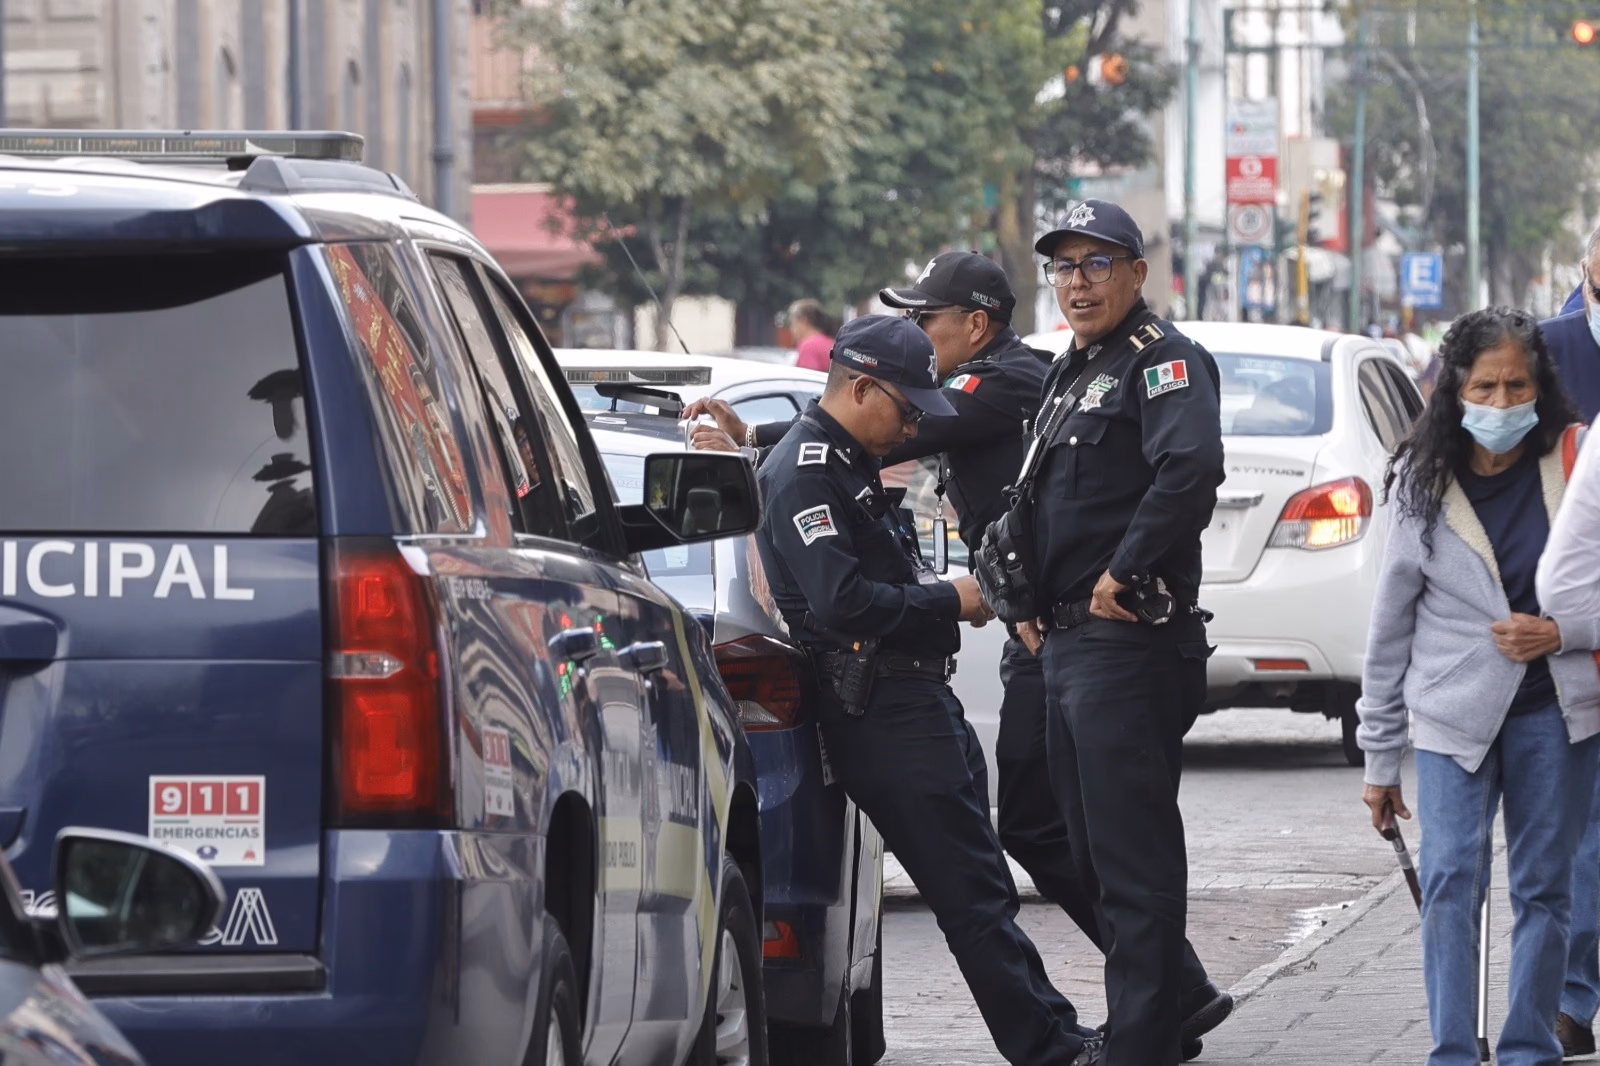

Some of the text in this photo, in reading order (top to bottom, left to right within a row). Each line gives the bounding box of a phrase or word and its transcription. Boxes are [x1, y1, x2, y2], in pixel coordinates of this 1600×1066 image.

[1410, 255, 1433, 290] E
[1095, 372, 1120, 389] LUCA
[1151, 380, 1185, 395] MEXICO
[800, 511, 826, 526] POLICIA
[805, 524, 834, 539] MUNICIPAL
[153, 827, 260, 839] EMERGENCIAS
